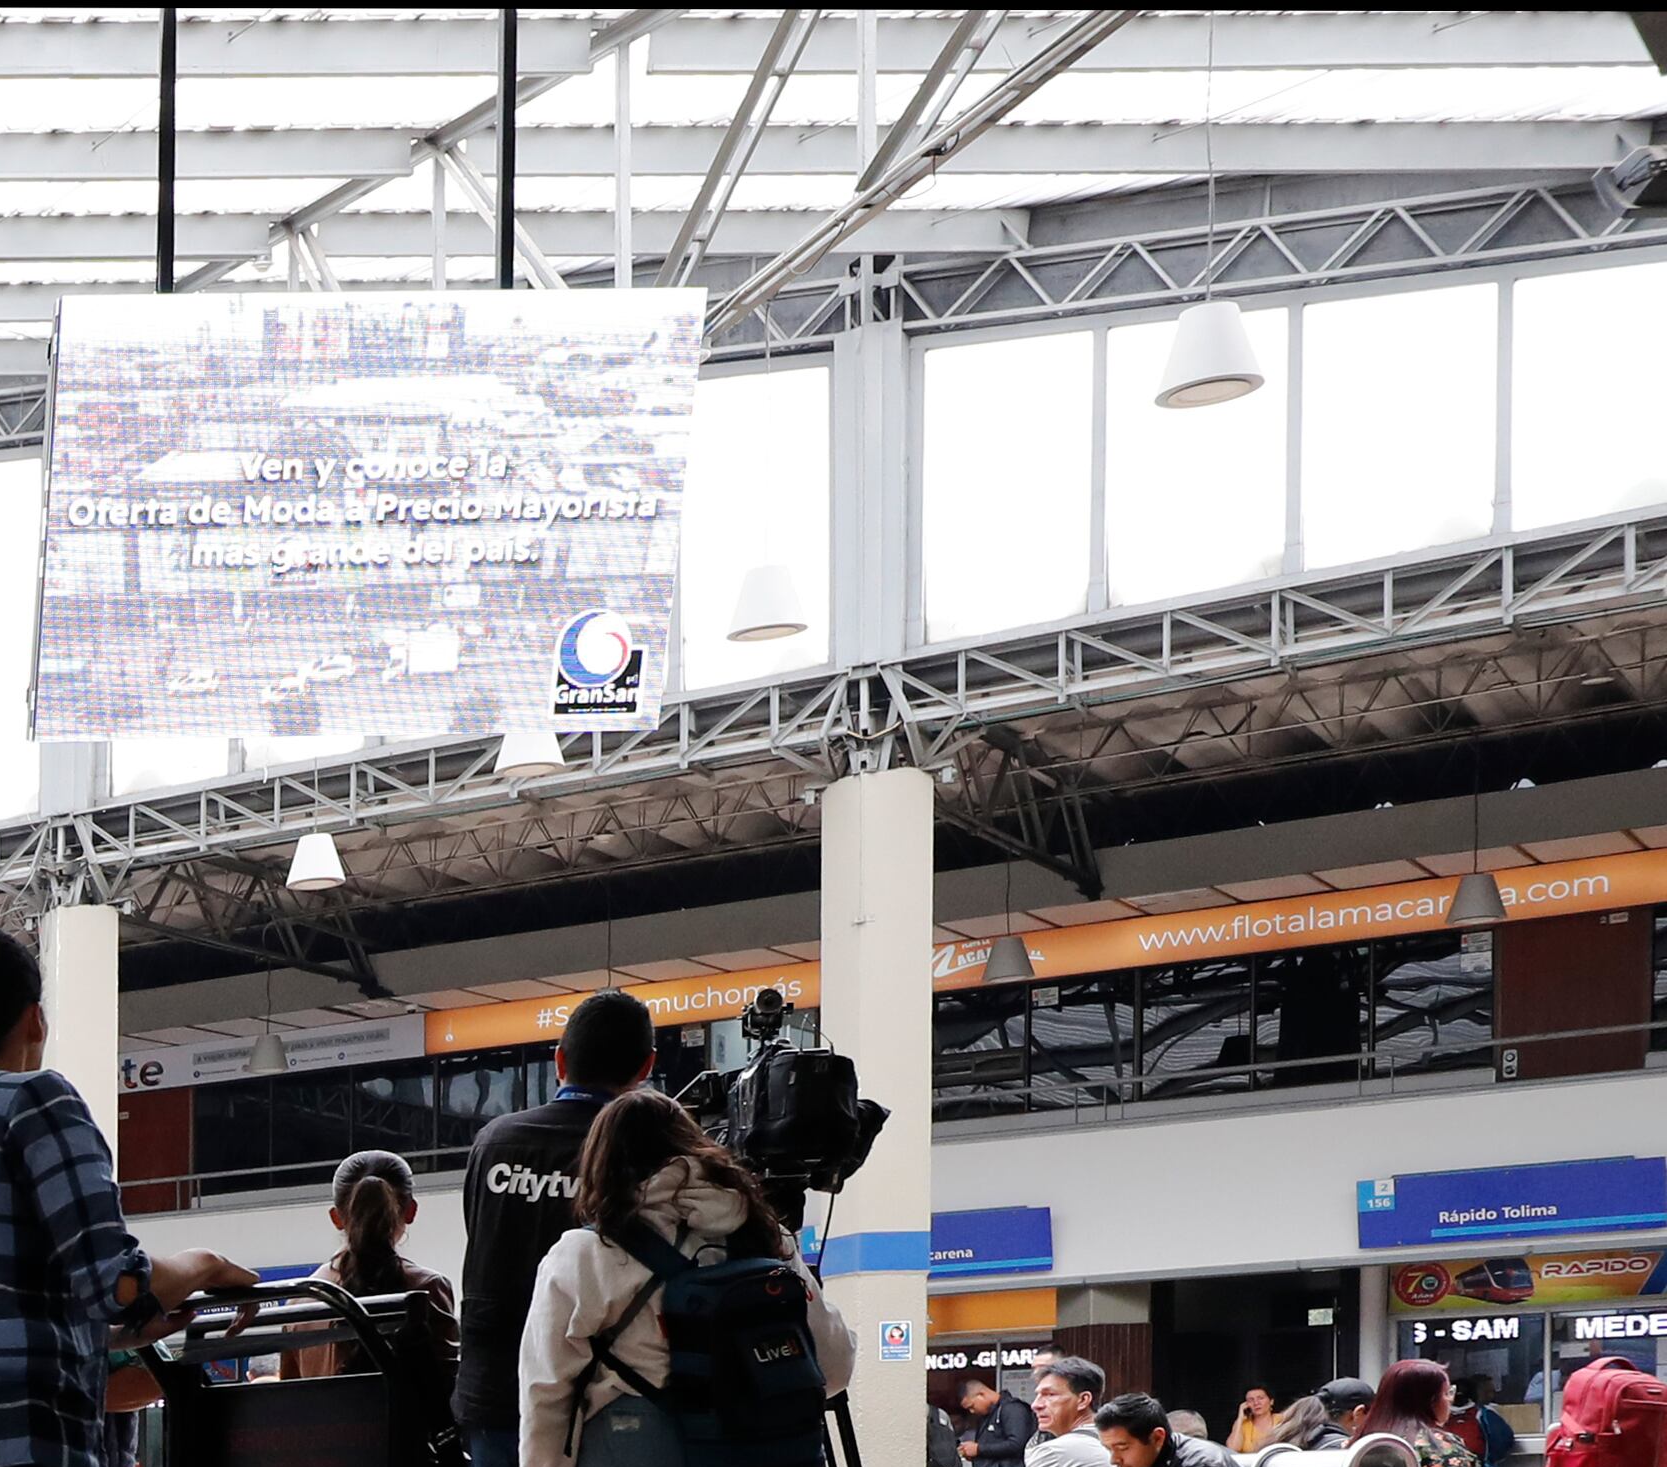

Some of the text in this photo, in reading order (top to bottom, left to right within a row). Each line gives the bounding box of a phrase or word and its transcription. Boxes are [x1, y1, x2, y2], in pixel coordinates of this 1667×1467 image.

[240, 452, 507, 487] Ven y conoce la
[68, 498, 178, 528] Oferta
[188, 497, 229, 525] de
[243, 496, 336, 525] Moda
[376, 493, 482, 522] Precio
[493, 490, 658, 528] Mayorista
[271, 536, 391, 573] grande
[401, 533, 454, 563] del
[555, 683, 641, 704] GranSan
[1138, 872, 1609, 952] www.flotalamacara.com
[121, 1058, 164, 1090] te
[486, 1161, 582, 1203] Citytv
[1380, 1183, 1389, 1192] 2
[1367, 1198, 1391, 1208] 156
[1439, 1204, 1557, 1225] Rápido Tolima
[1541, 1257, 1653, 1279] RAPIDO
[1451, 1317, 1520, 1342] SAM
[1575, 1313, 1667, 1340] MEDE
[924, 1352, 968, 1370] NCIO
